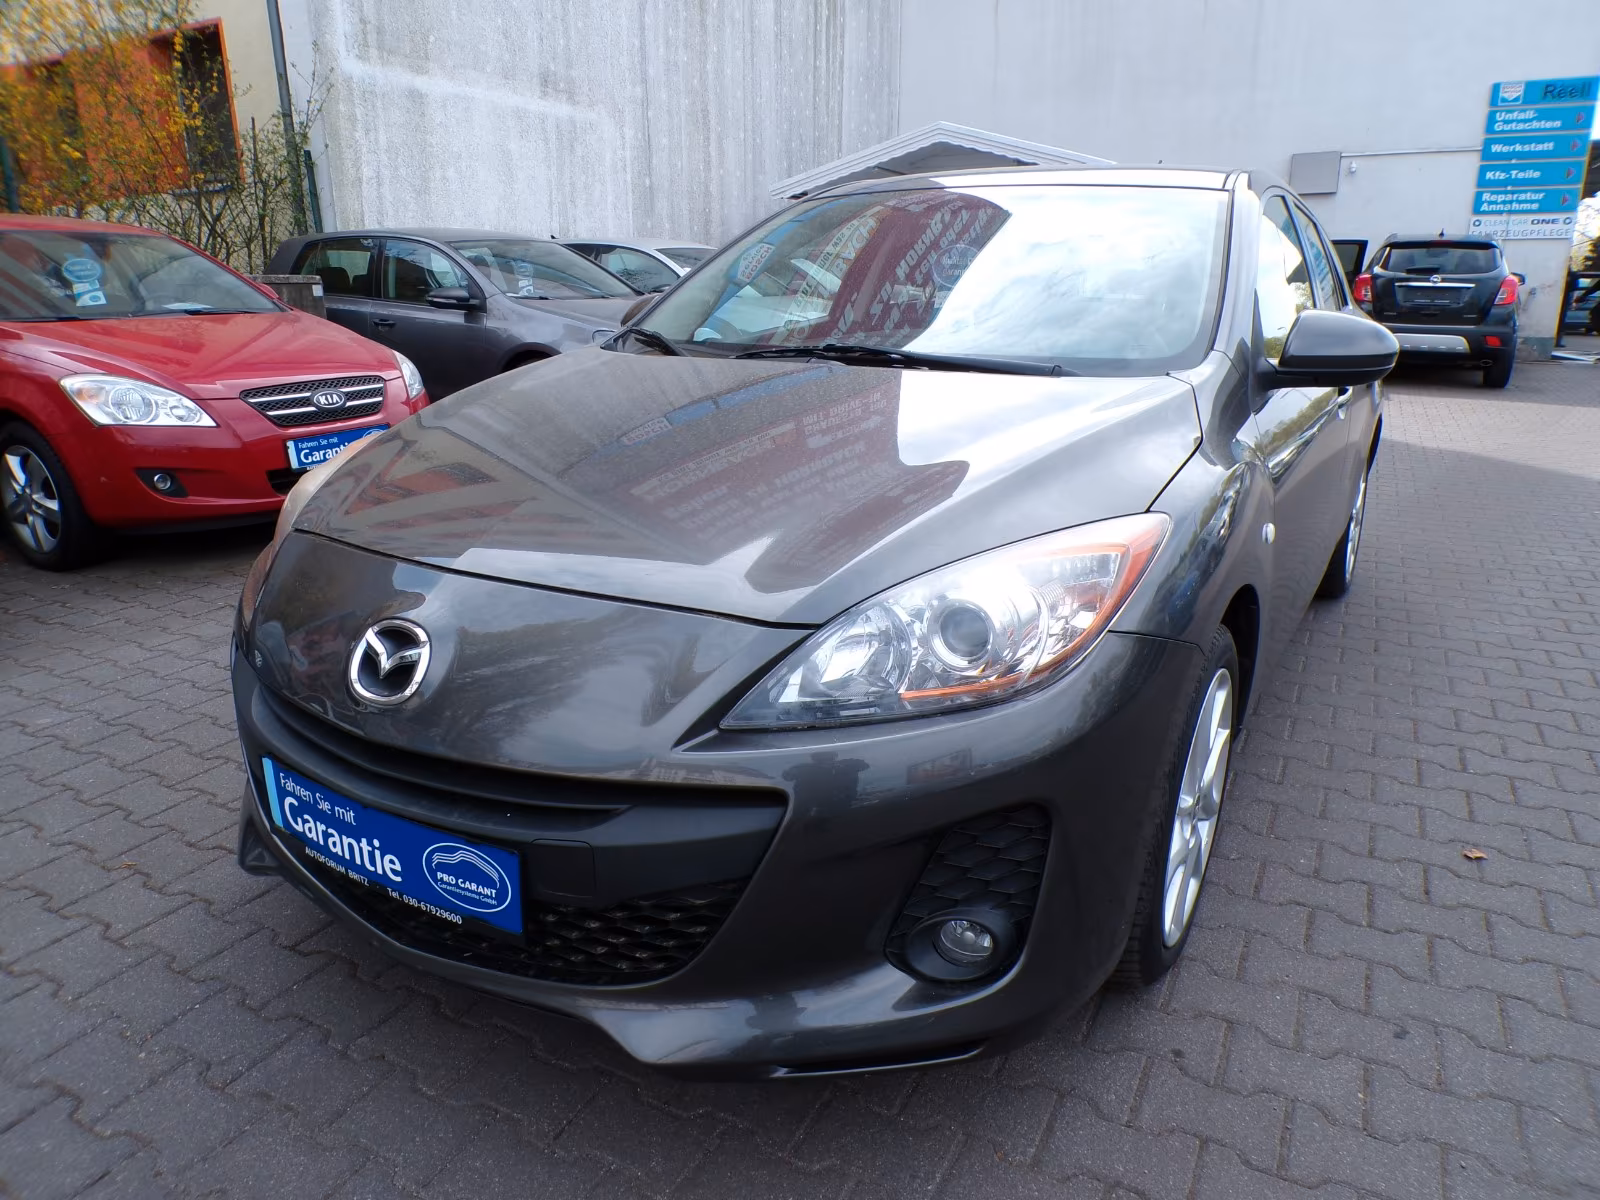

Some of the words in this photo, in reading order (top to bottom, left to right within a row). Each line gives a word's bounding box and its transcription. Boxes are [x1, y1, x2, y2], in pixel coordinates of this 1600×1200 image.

[1496, 111, 1538, 121] Unfall-
[1494, 120, 1561, 131] Gutachten
[1491, 141, 1554, 153] Werkstatt
[1485, 170, 1541, 180] Kfz-Teile
[1482, 191, 1545, 202] Reparatur
[1480, 202, 1539, 211] Annahme
[1484, 219, 1509, 227] CLEAN
[1511, 218, 1529, 226] CAR
[318, 393, 340, 405] KIA
[298, 441, 318, 449] Fahren
[279, 772, 313, 804] Fahren
[316, 792, 332, 814] Sie
[334, 806, 357, 825] mit
[284, 797, 403, 882] Garantie
[305, 846, 346, 875] AUTOFORUM
[347, 869, 370, 887] BRITZ
[386, 887, 403, 901] Tel.
[402, 894, 463, 924] 030-67929600
[436, 871, 456, 884] PRO
[457, 878, 496, 898] GARANT
